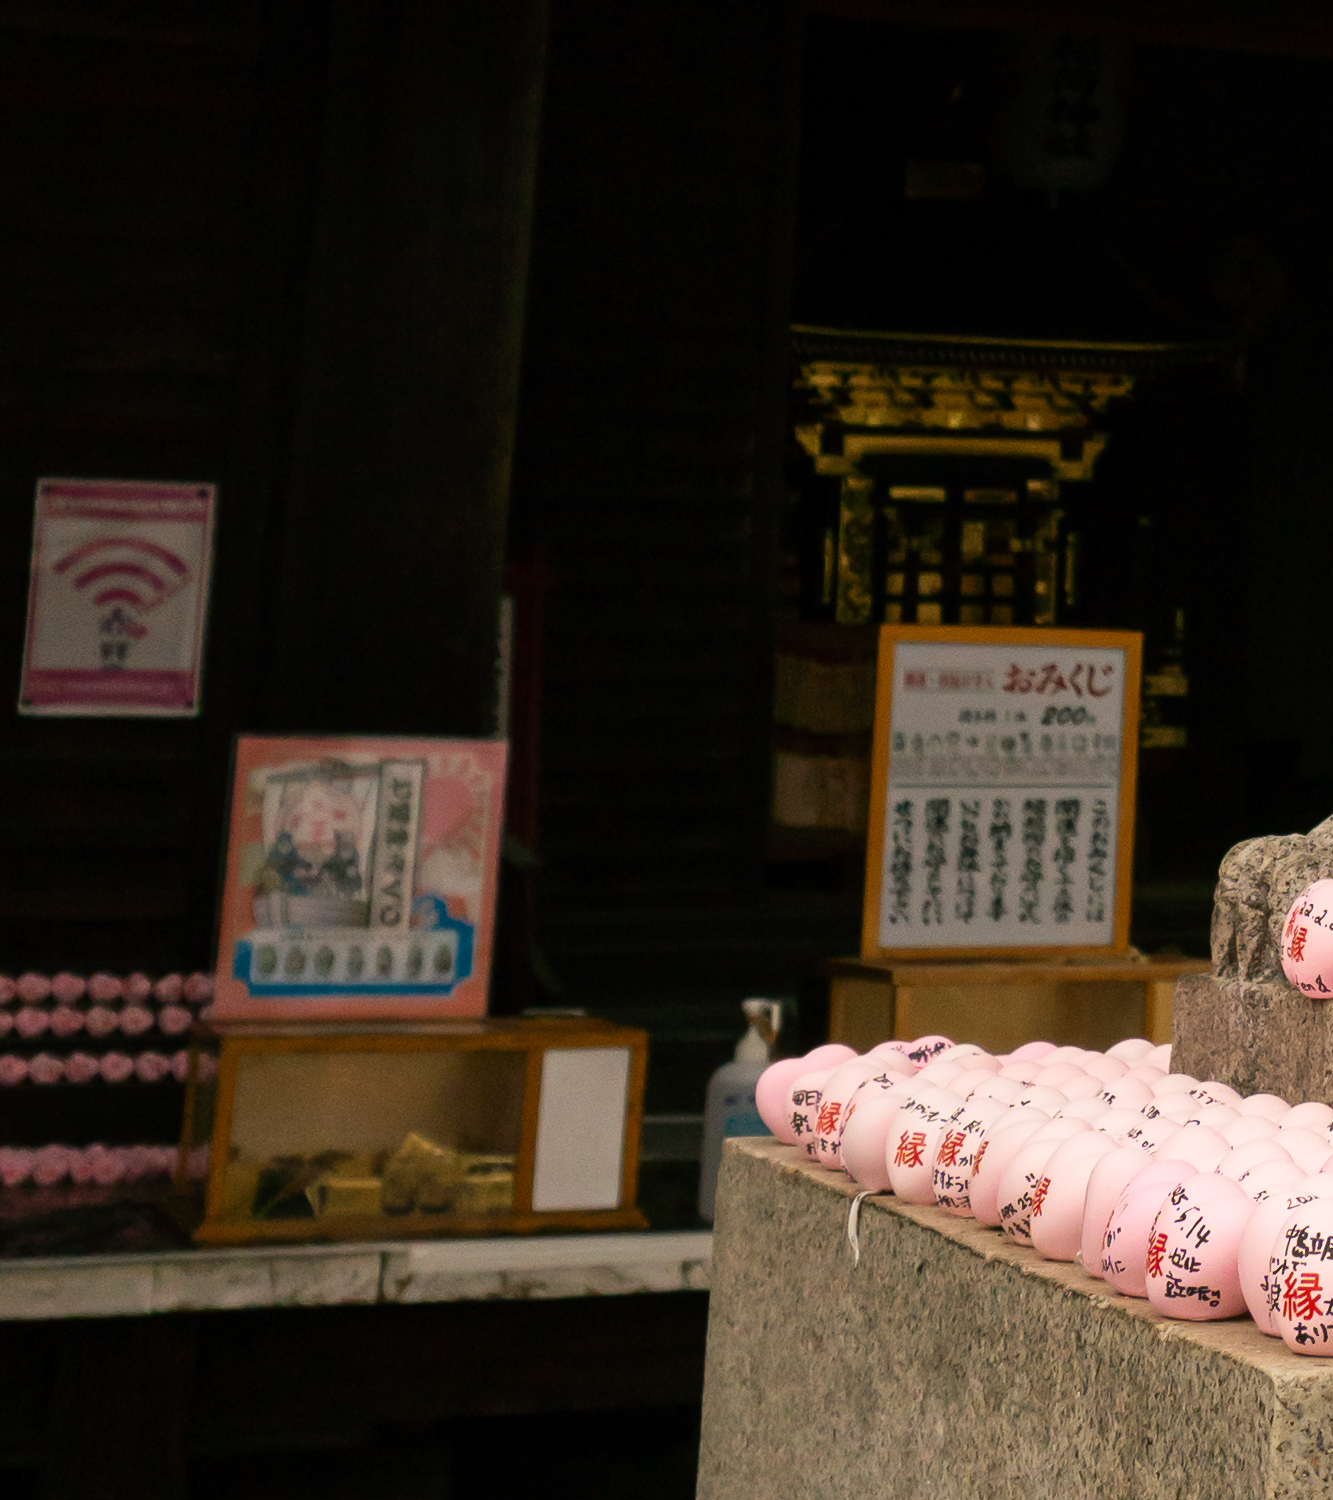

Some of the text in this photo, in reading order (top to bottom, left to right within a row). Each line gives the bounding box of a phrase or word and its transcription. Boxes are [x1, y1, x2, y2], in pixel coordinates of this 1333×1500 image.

[1003, 661, 1114, 698] おみくじ
[815, 1100, 842, 1137] 縁
[893, 1129, 927, 1169] 縁
[936, 1128, 967, 1168] 縁
[1282, 1271, 1323, 1321] 縁
